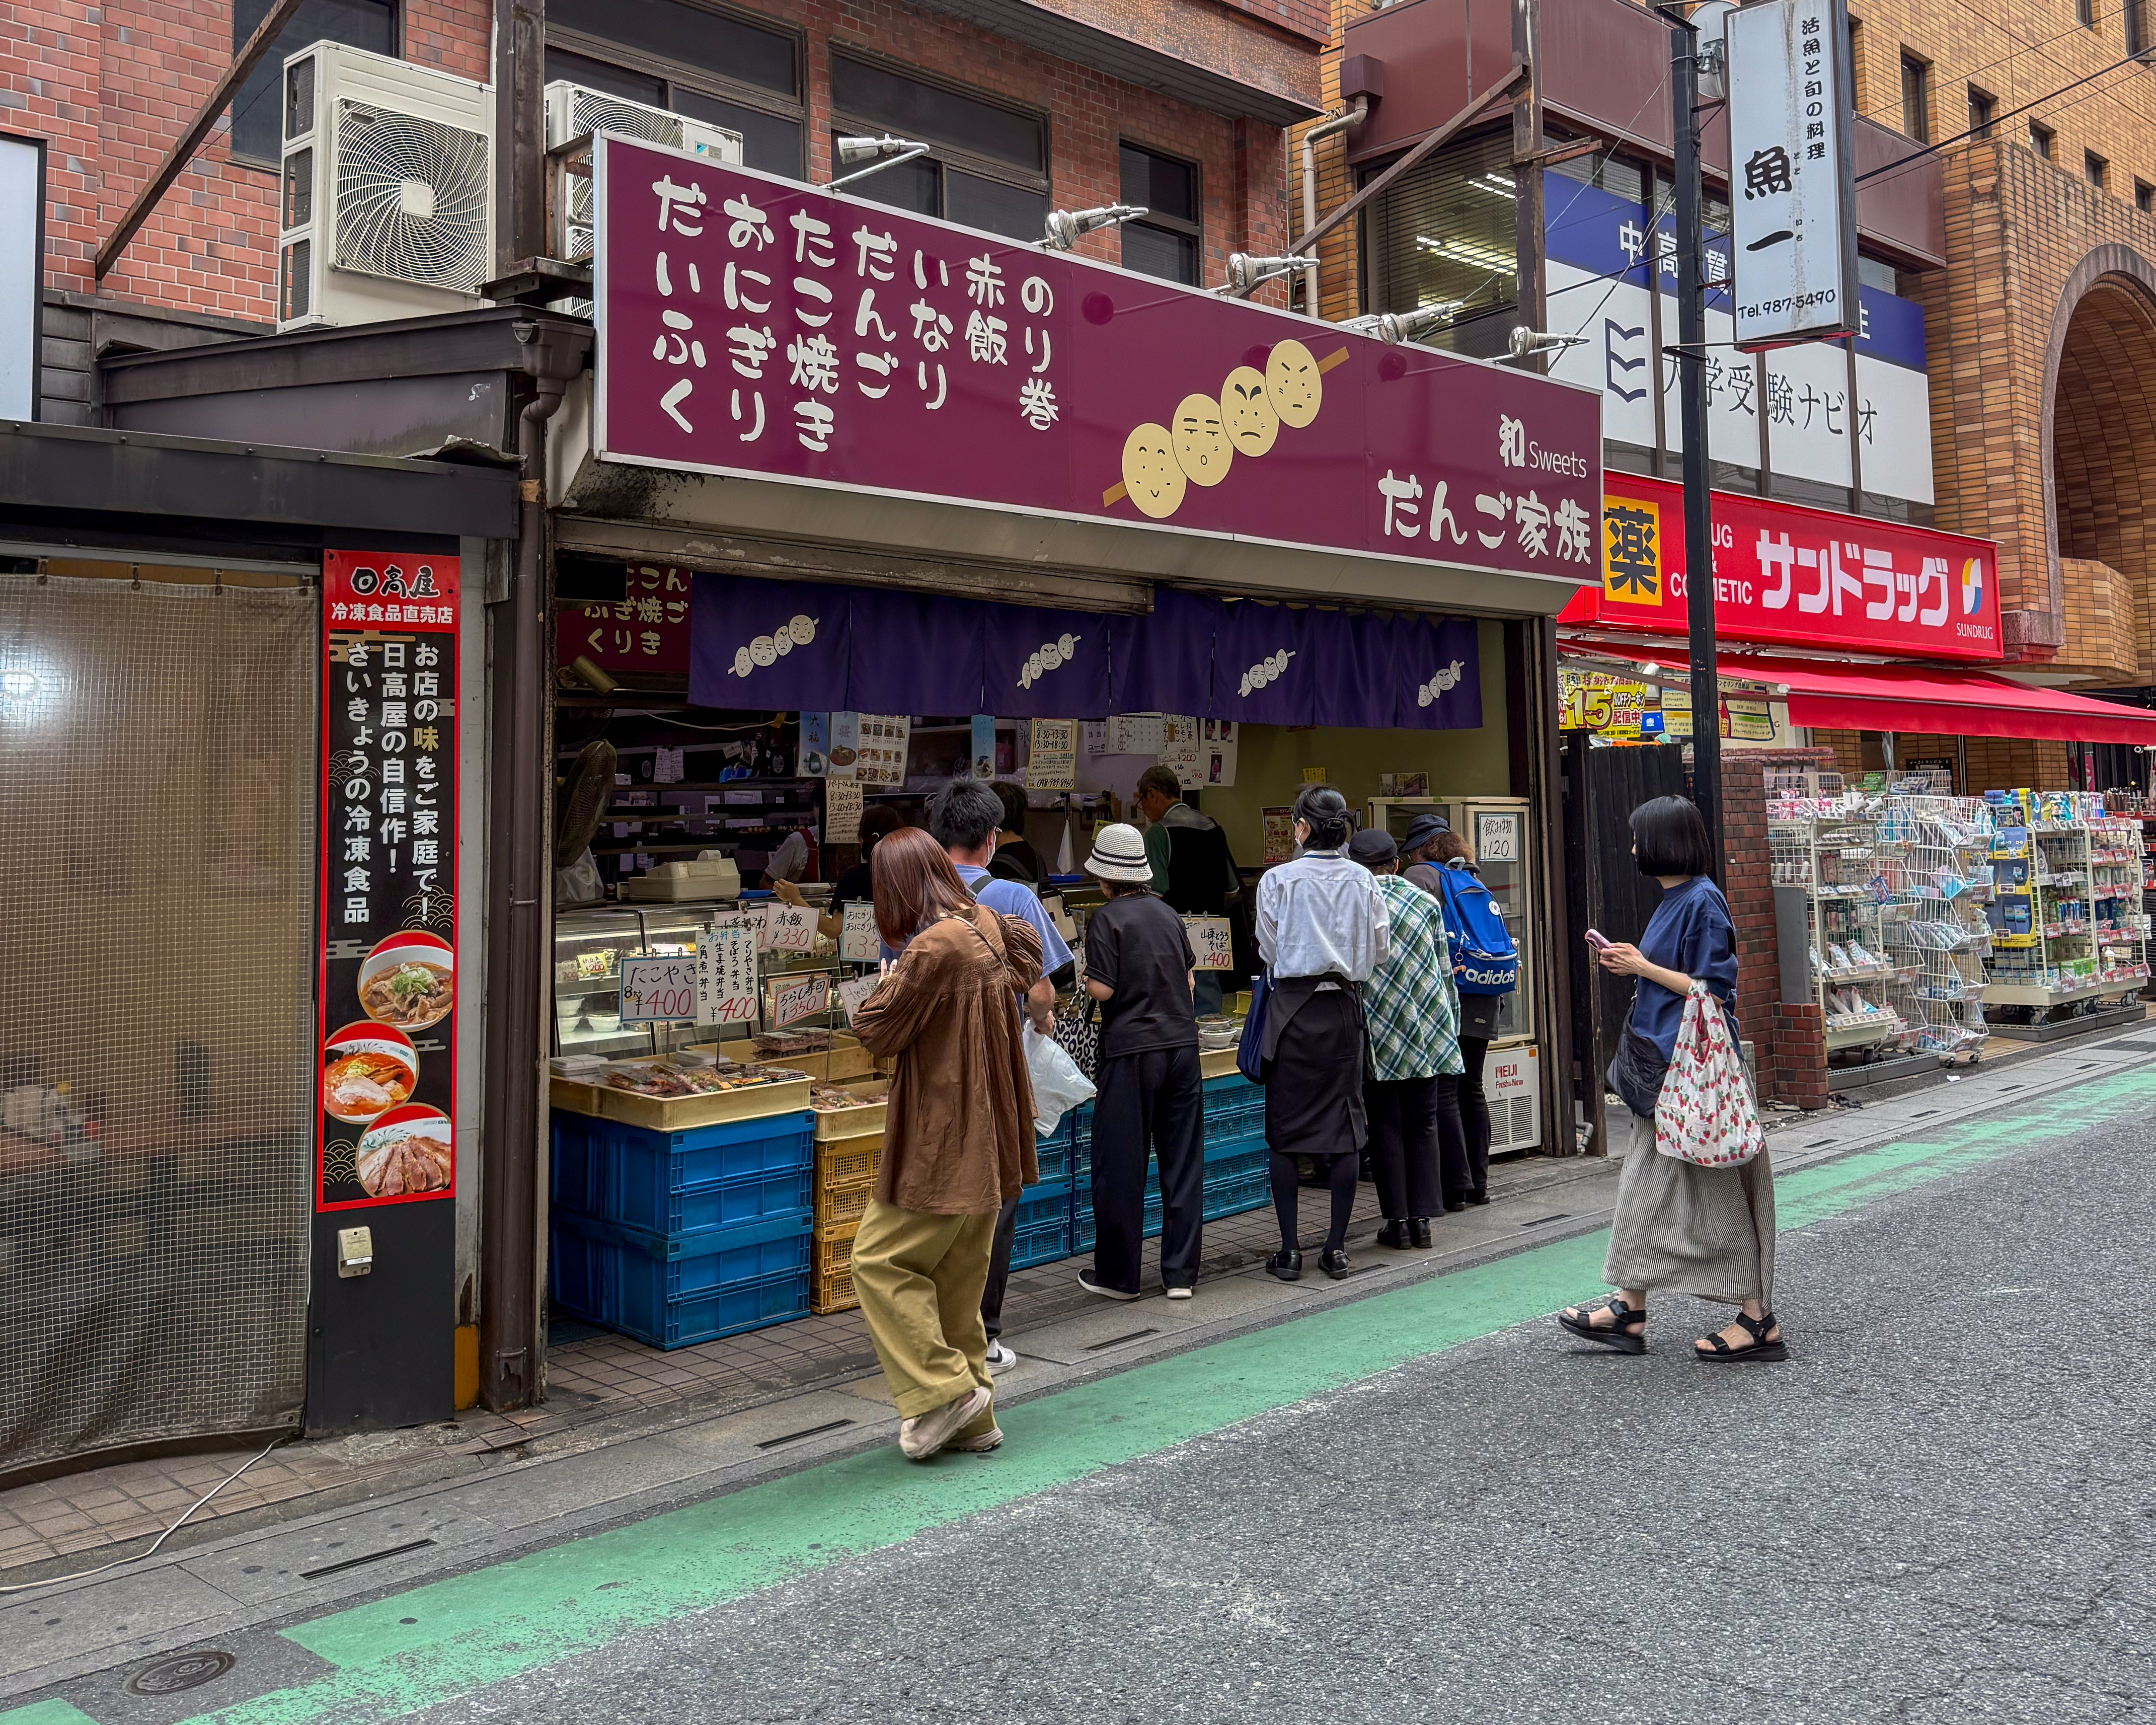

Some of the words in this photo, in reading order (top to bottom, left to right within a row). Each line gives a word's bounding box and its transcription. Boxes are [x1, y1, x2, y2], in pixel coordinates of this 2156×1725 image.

[1802, 17, 1825, 161] 活魚と旬の料理
[1743, 145, 1794, 252] 魚一
[652, 174, 707, 434] だいふく
[723, 193, 777, 442] おにぎり
[787, 208, 840, 453] たこ焼き
[852, 224, 899, 399] だんご
[910, 249, 954, 410] いなり
[964, 253, 1009, 366] 赤飯
[1738, 288, 1836, 320] Tel.987-5490
[1019, 275, 1059, 431] のり巻
[1499, 413, 1525, 468] 和
[1529, 441, 1587, 479] Sweets
[1378, 469, 1592, 564] だんご家族
[1604, 505, 1657, 595] 薬
[331, 602, 453, 625] 冷凍食品直売店
[351, 566, 440, 599] 日高屋
[1756, 529, 1949, 627] サンドラッグ
[1956, 622, 1993, 640] SUNDRUG
[809, 715, 819, 743] 大福
[343, 642, 371, 923] さいきょうの冷凍食品
[775, 911, 803, 927] 赤飯
[630, 963, 696, 986] たこやき
[780, 981, 825, 1007] ちらし寿司
[1465, 968, 1514, 985] adidas
[1495, 1064, 1517, 1078] MEIJI
